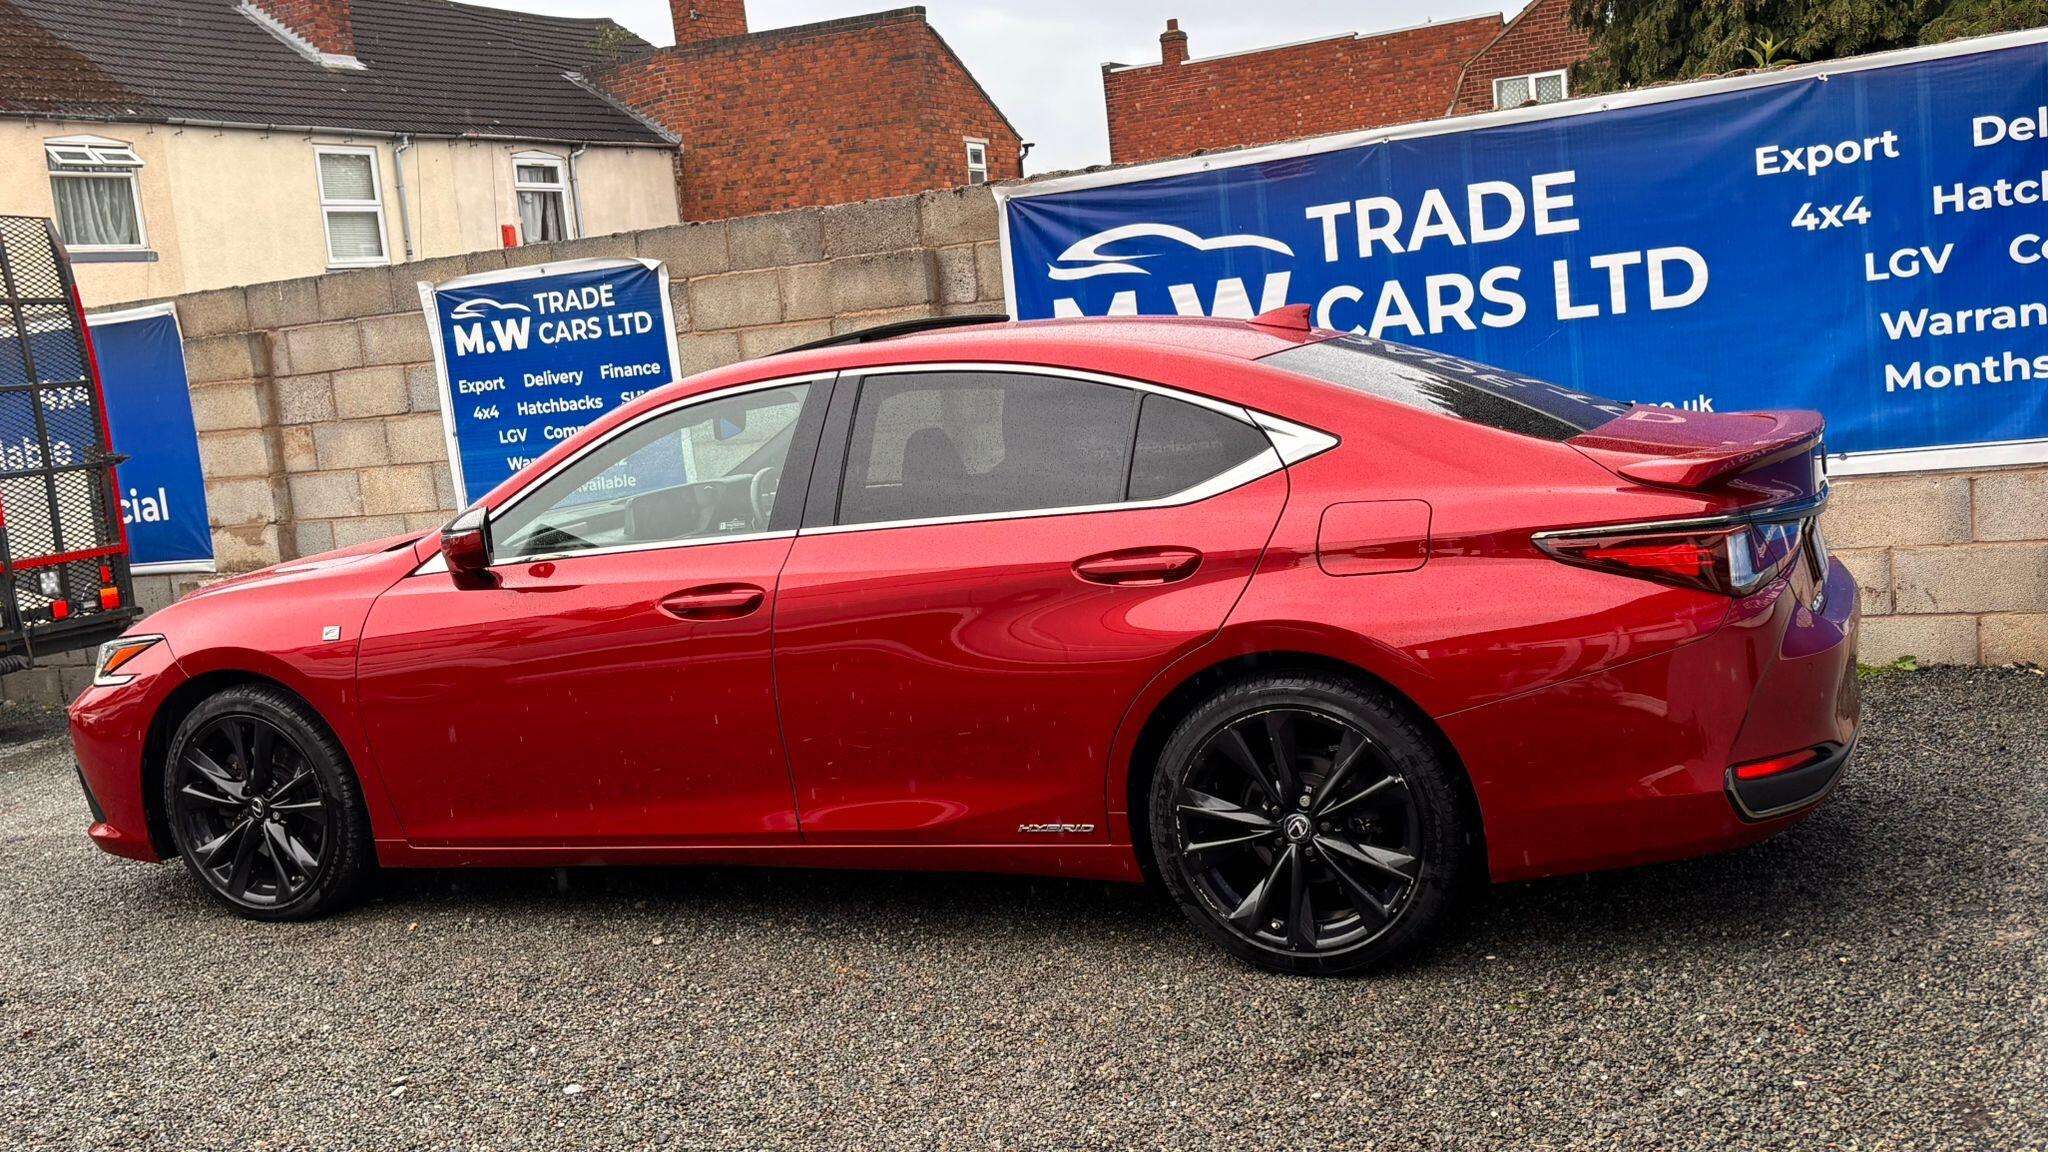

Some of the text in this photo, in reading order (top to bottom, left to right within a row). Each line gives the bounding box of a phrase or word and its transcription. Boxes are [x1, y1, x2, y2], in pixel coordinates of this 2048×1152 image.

[1756, 106, 2047, 175] Export Del
[1306, 171, 1579, 262] TRADE
[1792, 170, 2048, 230] 4x4 Hatc
[1865, 244, 1953, 281] LGV
[533, 283, 615, 315] TRADE
[1317, 266, 1527, 337] CARS
[1554, 247, 1709, 319] LTD
[453, 316, 531, 356] M.W
[538, 311, 653, 344] CARS LTD
[1881, 303, 2047, 339] Warran
[459, 362, 661, 395] Export Delivery Finance
[1886, 352, 2048, 391] Months
[473, 404, 500, 420] 4x4
[517, 395, 603, 416] Hatchbacks
[499, 428, 528, 444] LGV
[579, 474, 636, 493] vailable
[1018, 824, 1095, 833] HYBRID
